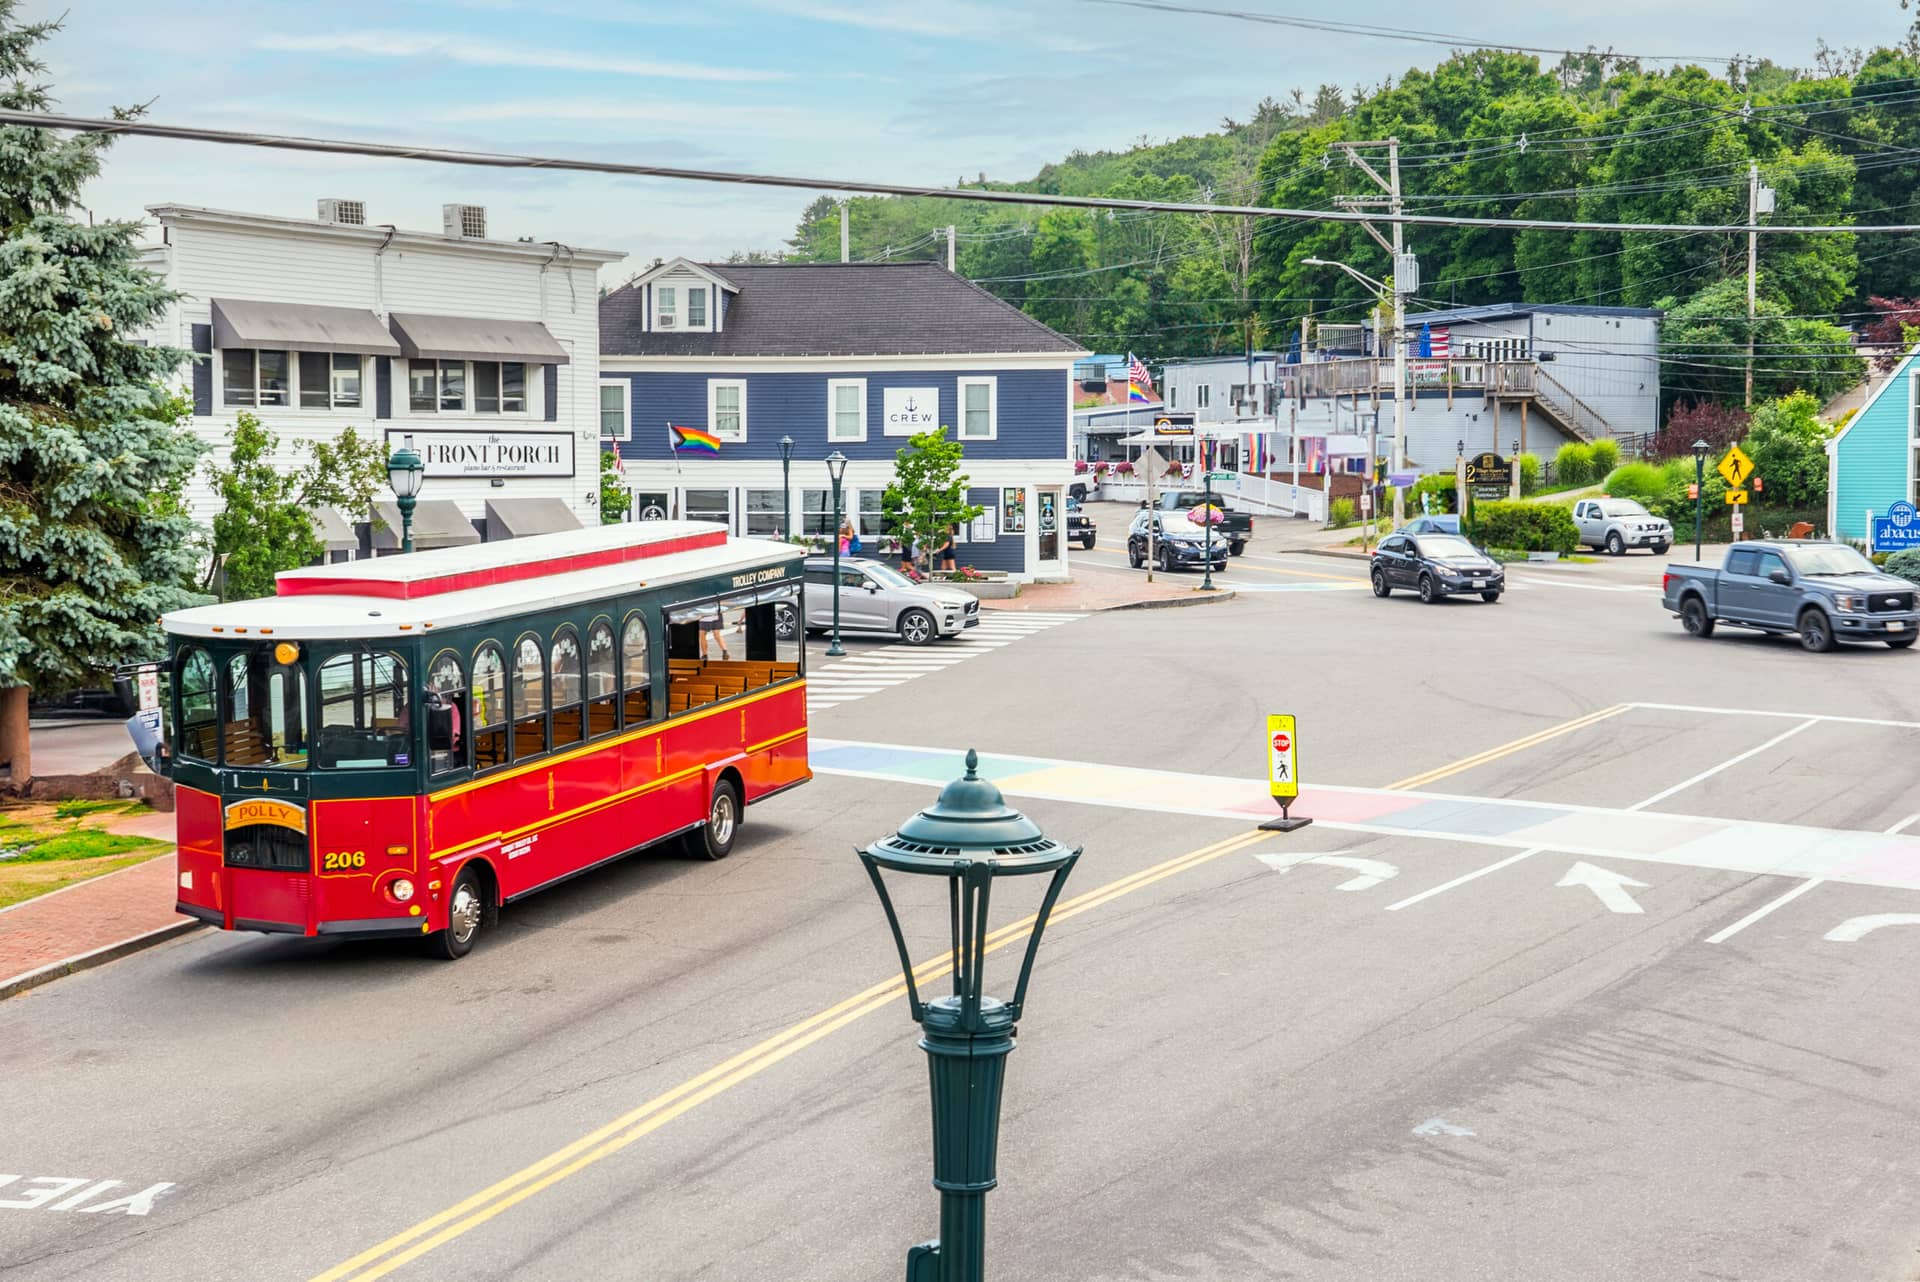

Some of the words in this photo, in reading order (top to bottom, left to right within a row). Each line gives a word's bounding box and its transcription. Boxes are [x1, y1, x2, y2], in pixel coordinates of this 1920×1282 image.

[890, 414, 933, 422] CREW
[488, 434, 500, 444] the
[427, 444, 492, 463] FRONT
[498, 445, 560, 464] PORCH
[464, 464, 480, 473] piano
[481, 463, 491, 471] bar
[1466, 464, 1476, 483] 2
[731, 572, 757, 588] TROLLEY
[757, 566, 786, 582] COMPANY
[1273, 739, 1290, 747] STOP
[239, 805, 290, 819] POLLY
[324, 851, 366, 870] 206
